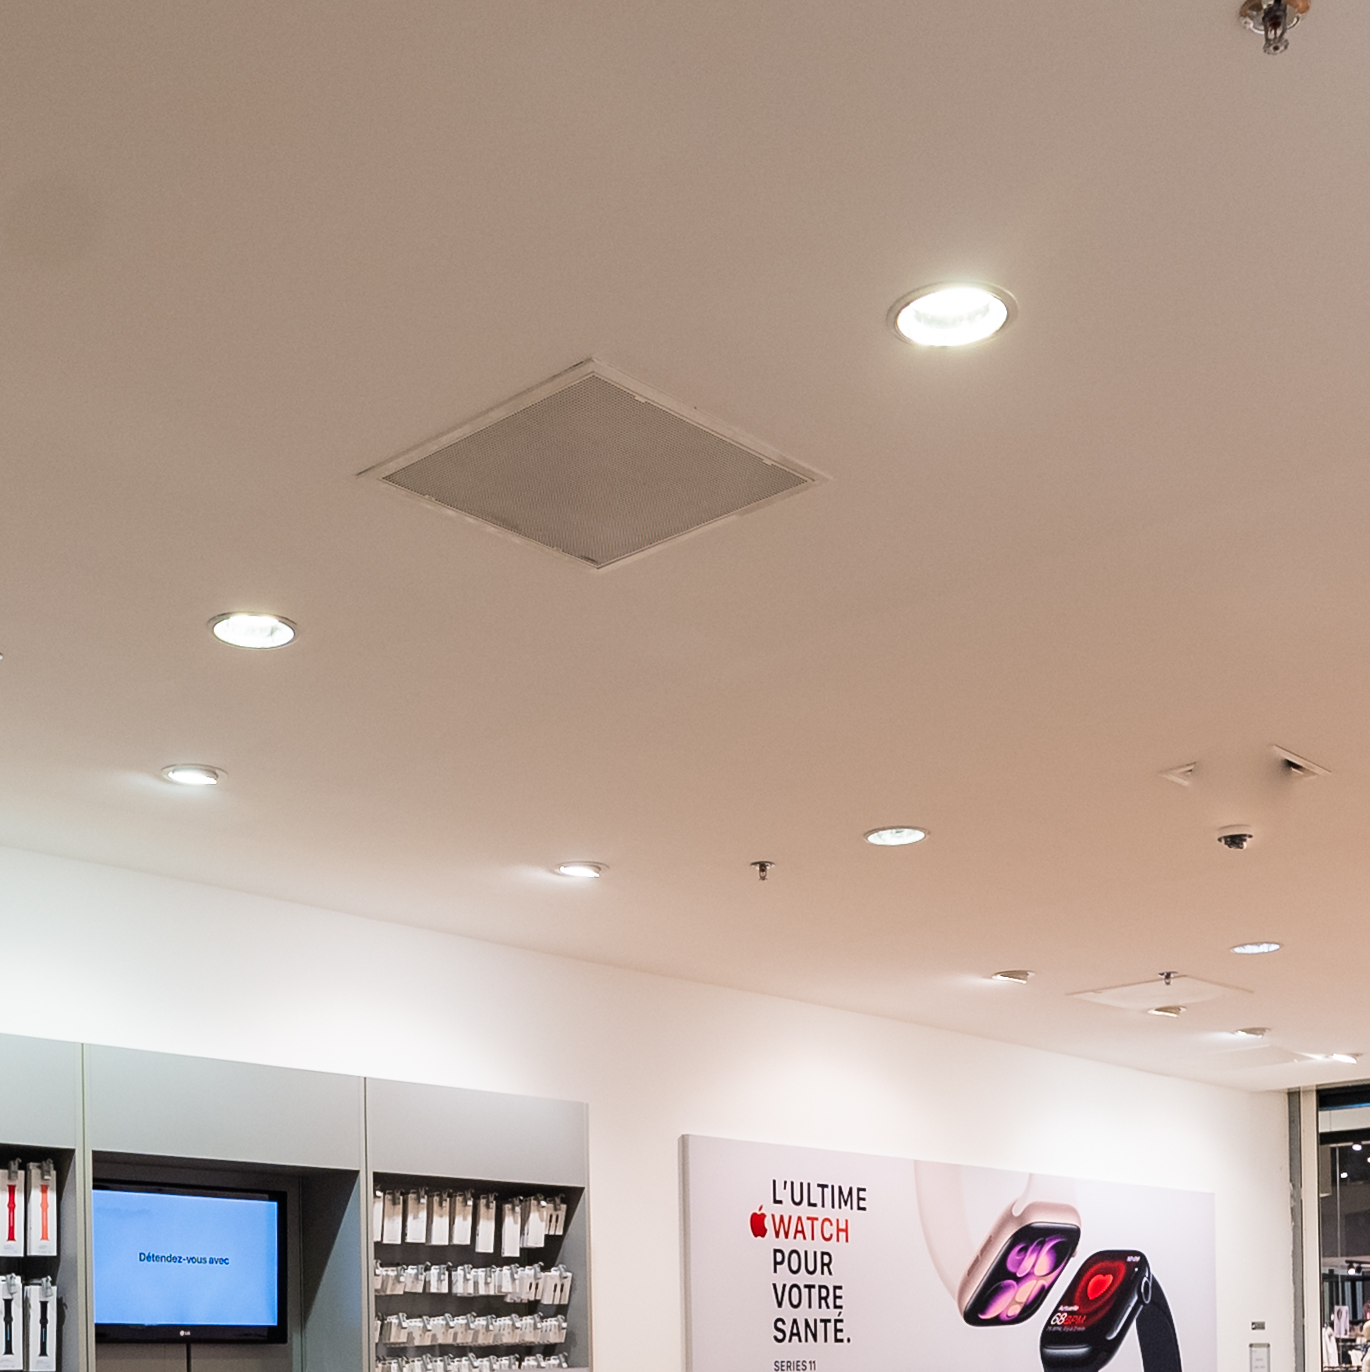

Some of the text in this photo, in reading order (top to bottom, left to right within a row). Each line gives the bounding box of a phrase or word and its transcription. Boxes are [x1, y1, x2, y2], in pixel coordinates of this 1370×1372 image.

[772, 1179, 867, 1211] L'ULTIME
[771, 1213, 850, 1244] WATCH
[138, 1252, 230, 1265] Détendez-vous avec
[773, 1248, 833, 1276] POUR
[772, 1283, 844, 1310] VOTRE
[773, 1311, 851, 1344] SANTÉ.
[774, 1360, 817, 1372] SERIES 11
